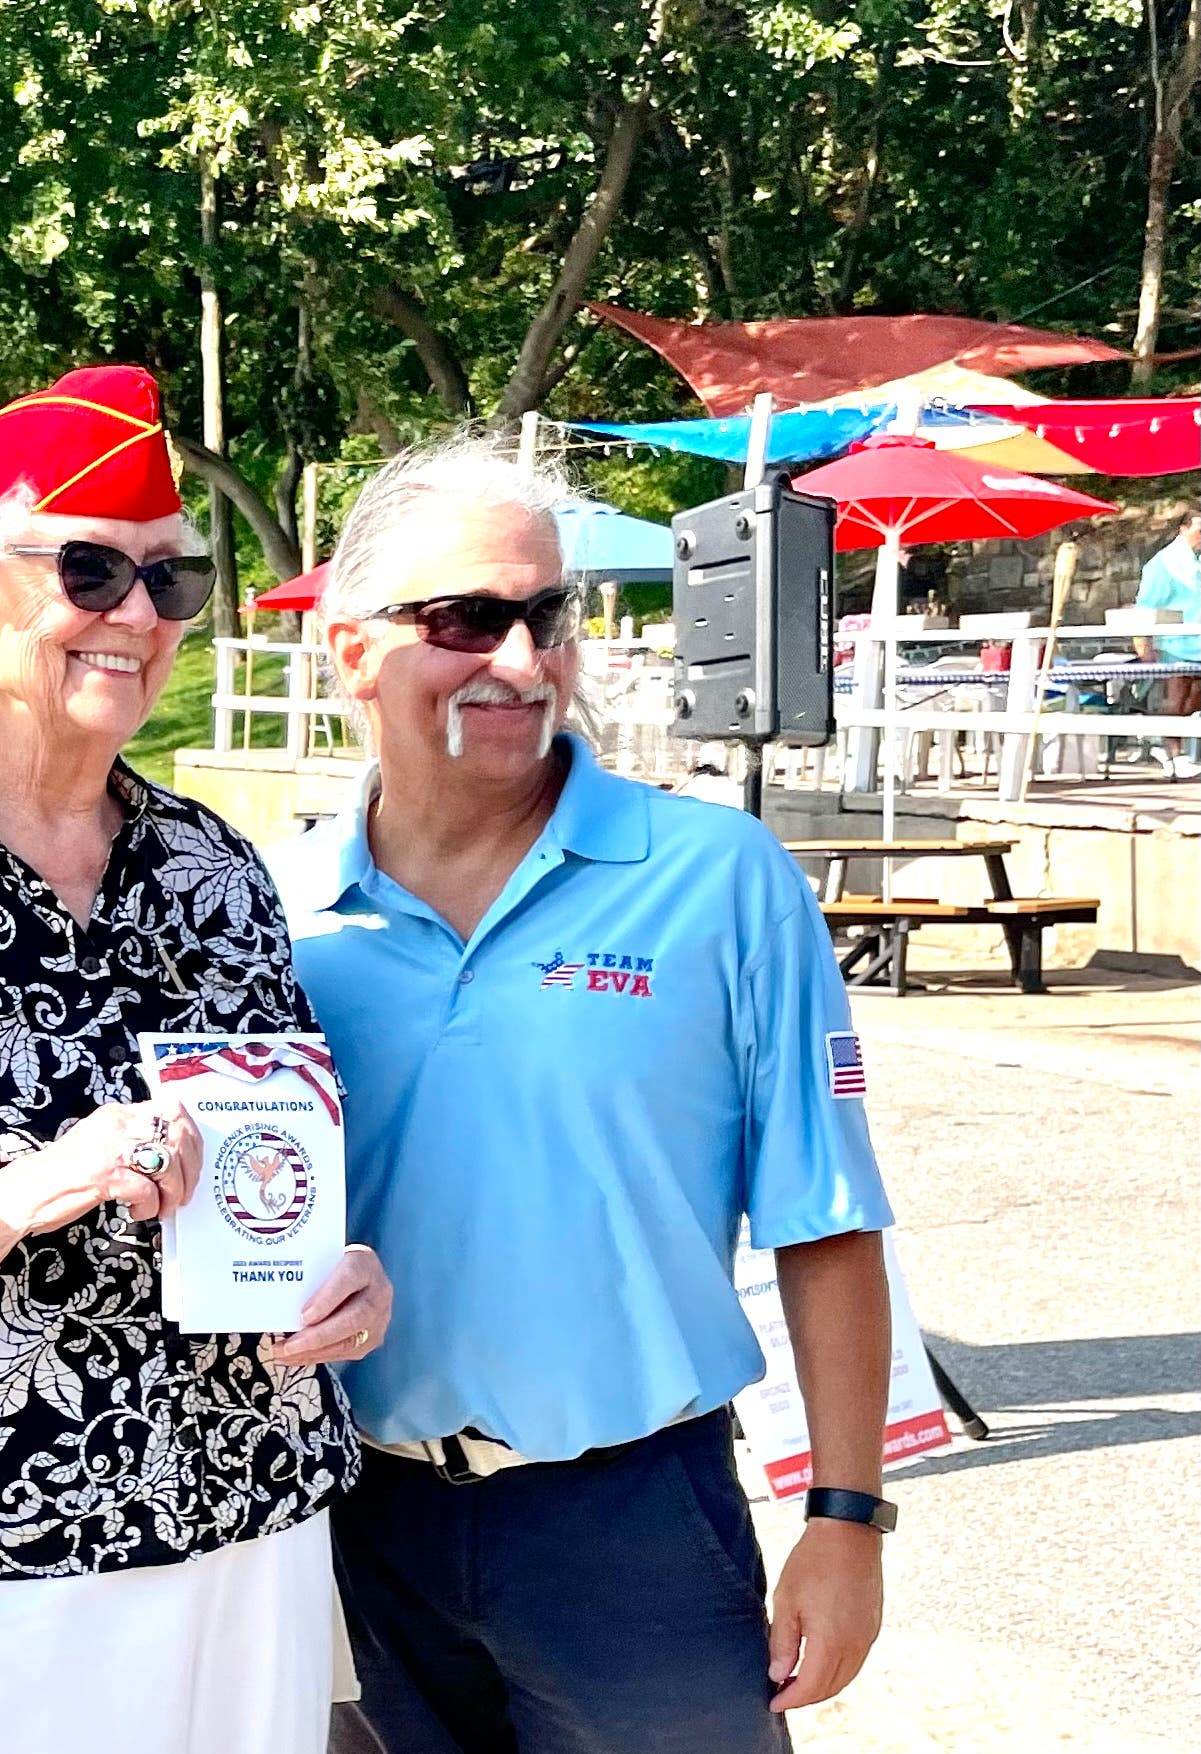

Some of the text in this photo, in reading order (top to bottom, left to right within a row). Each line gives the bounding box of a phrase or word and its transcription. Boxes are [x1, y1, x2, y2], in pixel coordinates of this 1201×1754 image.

[587, 953, 654, 972] TEAM
[587, 970, 653, 997] EVA
[197, 1101, 315, 1112] CONGRATULATIONS
[214, 1123, 313, 1170] PHOENIX RISING AWARDS
[265, 1235, 286, 1245] OUR
[287, 1186, 317, 1238] VETERANS
[232, 1271, 304, 1282] THANK YOU
